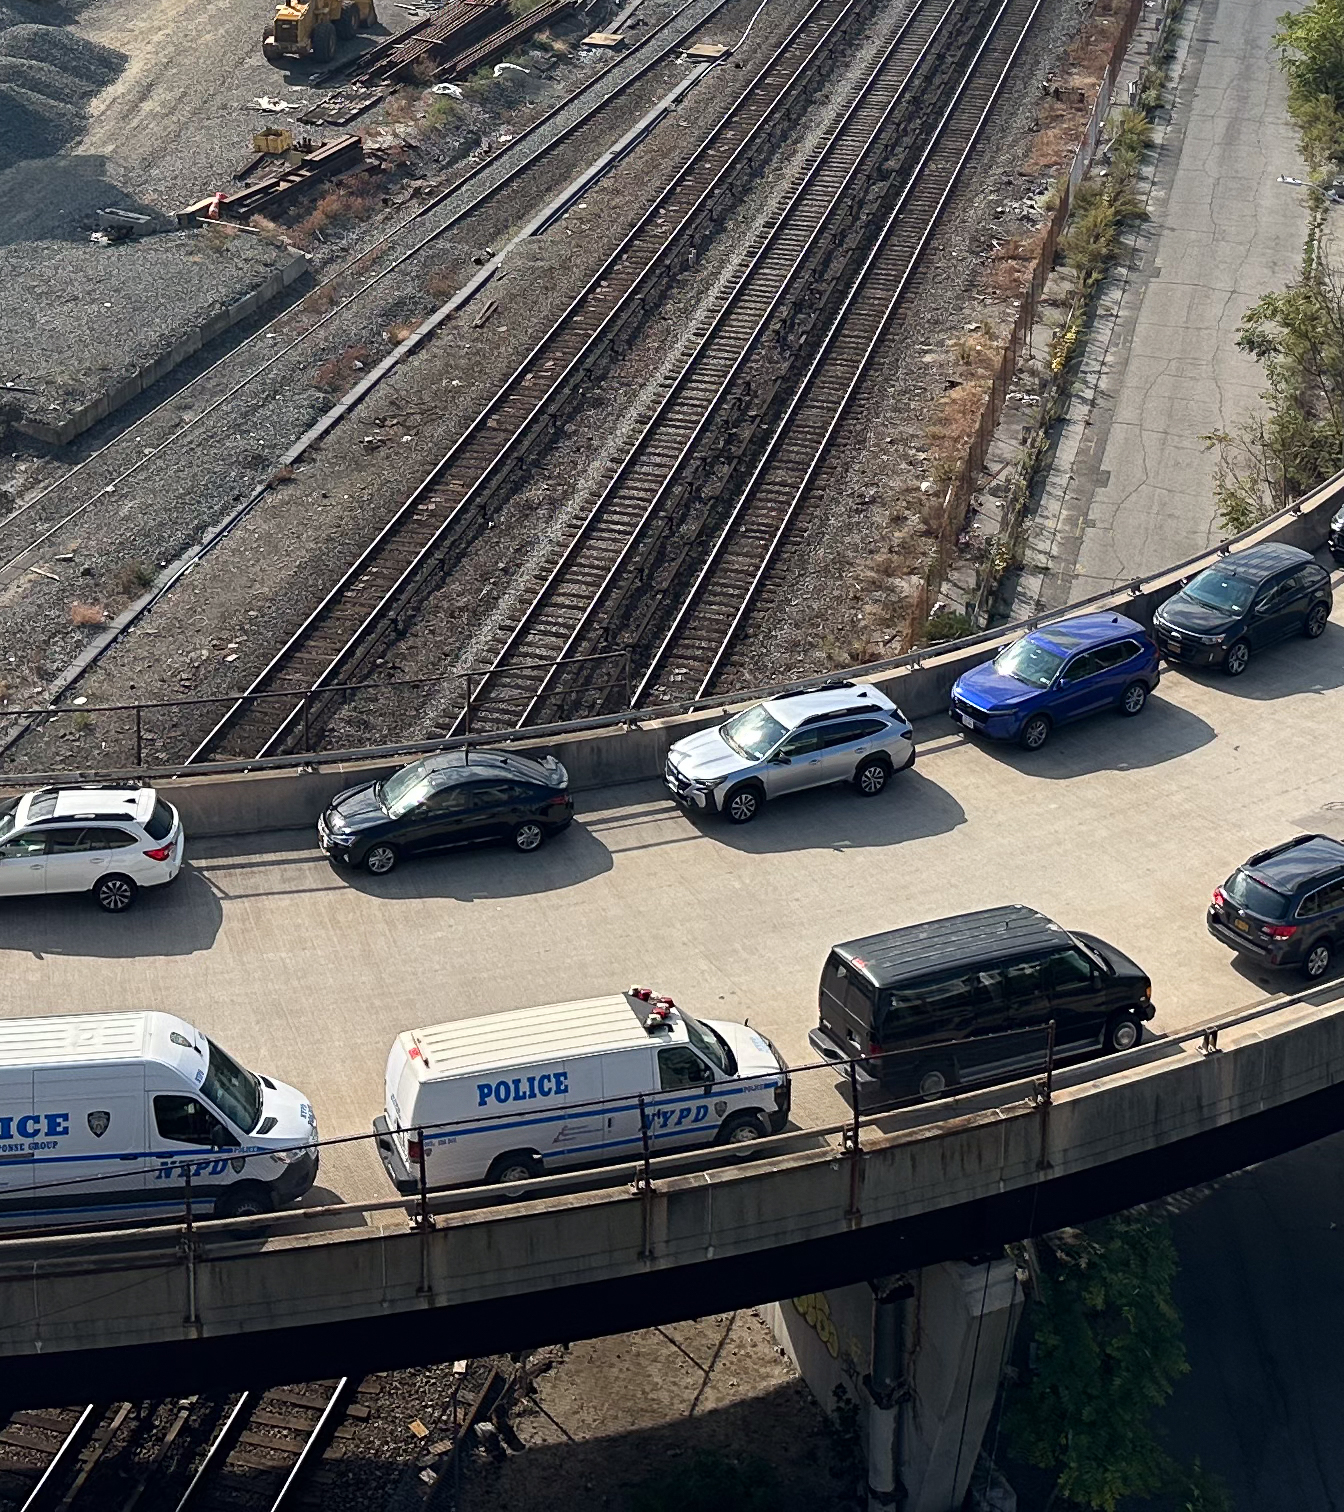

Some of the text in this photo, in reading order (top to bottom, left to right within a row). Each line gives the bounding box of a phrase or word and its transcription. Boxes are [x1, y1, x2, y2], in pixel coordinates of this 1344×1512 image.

[476, 1071, 569, 1107] POLICE
[644, 1104, 709, 1131] NYPD
[28, 1141, 58, 1150] GROUP
[155, 1159, 229, 1180] NYPD
